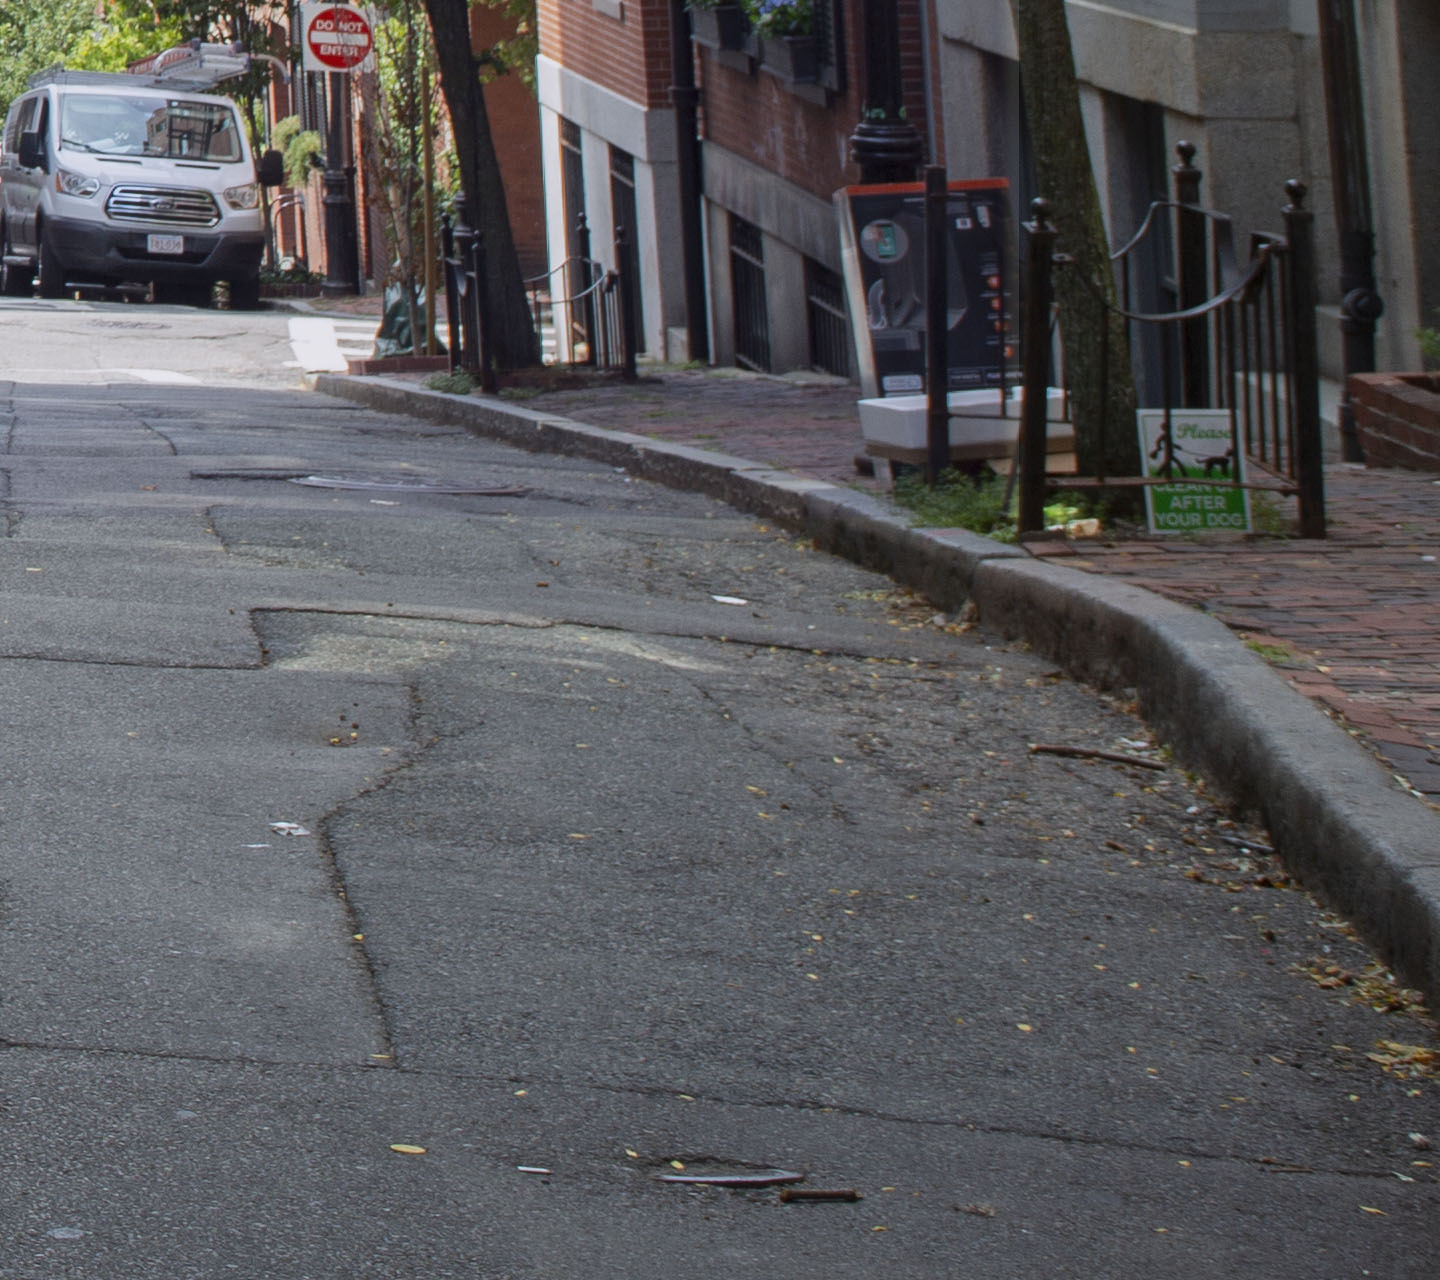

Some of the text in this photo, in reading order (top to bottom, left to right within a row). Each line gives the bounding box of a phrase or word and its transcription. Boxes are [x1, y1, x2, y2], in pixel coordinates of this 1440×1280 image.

[316, 20, 363, 32] DO NOT
[320, 44, 358, 56] ENTER
[1170, 495, 1226, 510] AFTER
[1155, 512, 1242, 527] YOUR DOG
